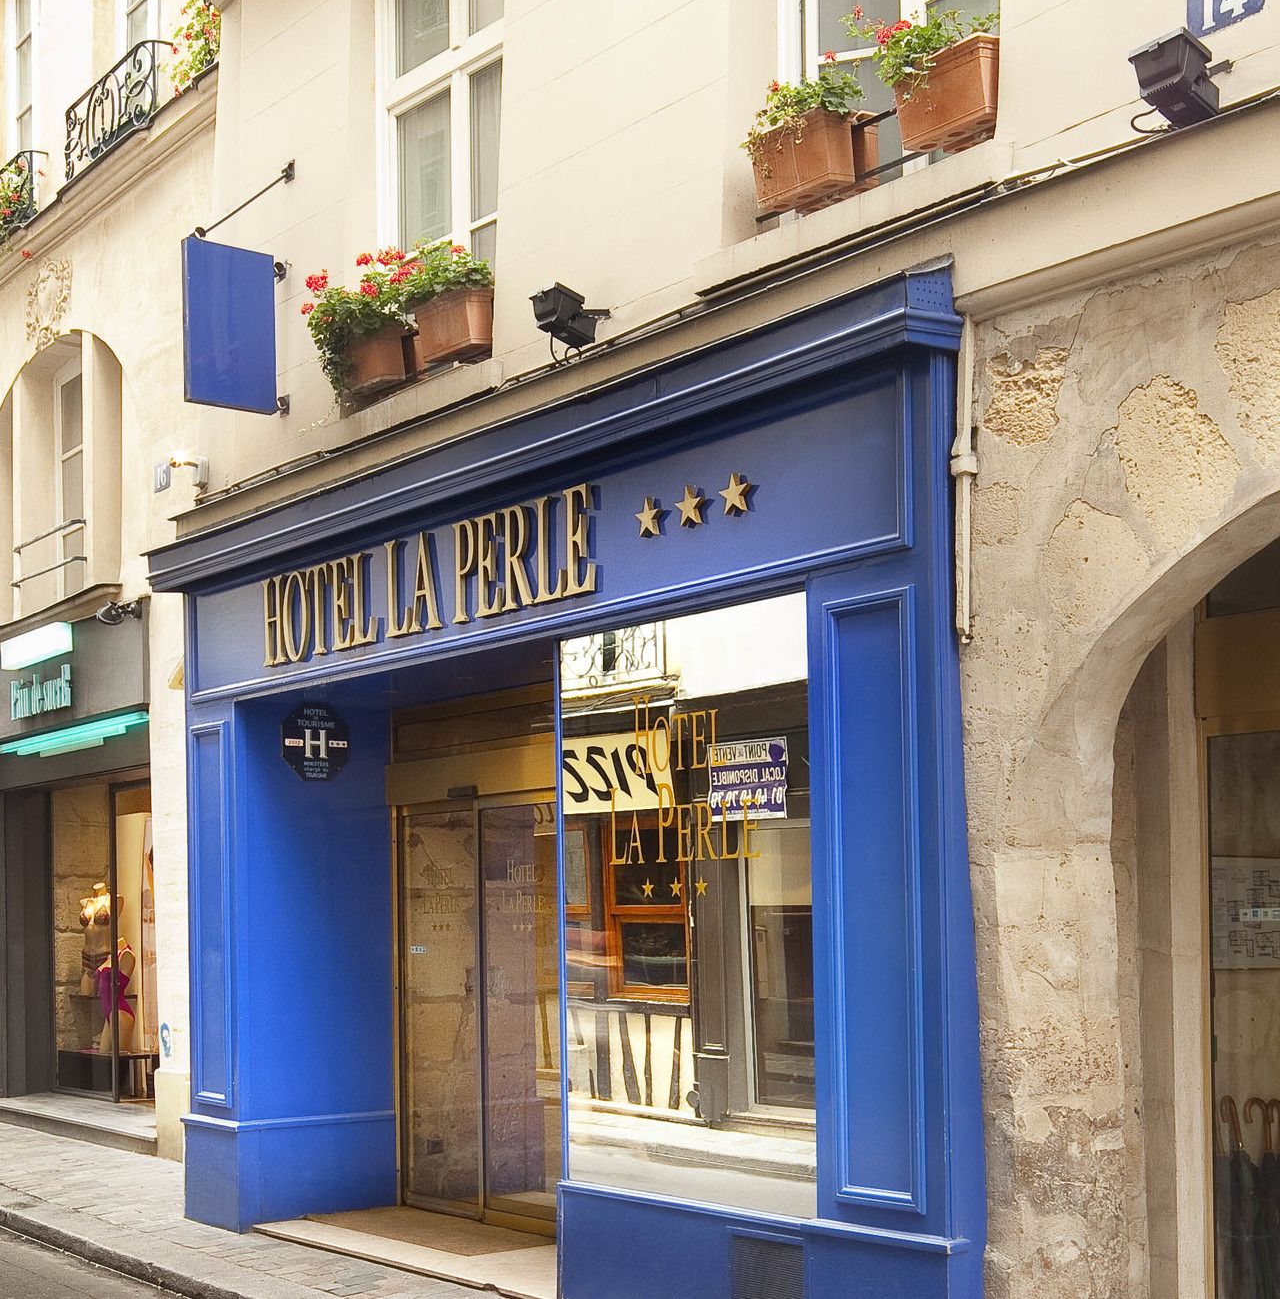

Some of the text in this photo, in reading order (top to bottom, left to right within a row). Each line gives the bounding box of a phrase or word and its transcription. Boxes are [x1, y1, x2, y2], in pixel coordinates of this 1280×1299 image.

[156, 463, 167, 489] 16
[262, 482, 596, 667] HOTEL LA PERLE
[297, 719, 335, 729] TOURISME
[304, 708, 329, 717] HOTEL
[304, 729, 329, 759] H
[632, 694, 727, 775] HOTEL
[609, 782, 761, 865] LA PERLE
[507, 859, 538, 883] HOTEL
[502, 889, 547, 914] LA PERLE
